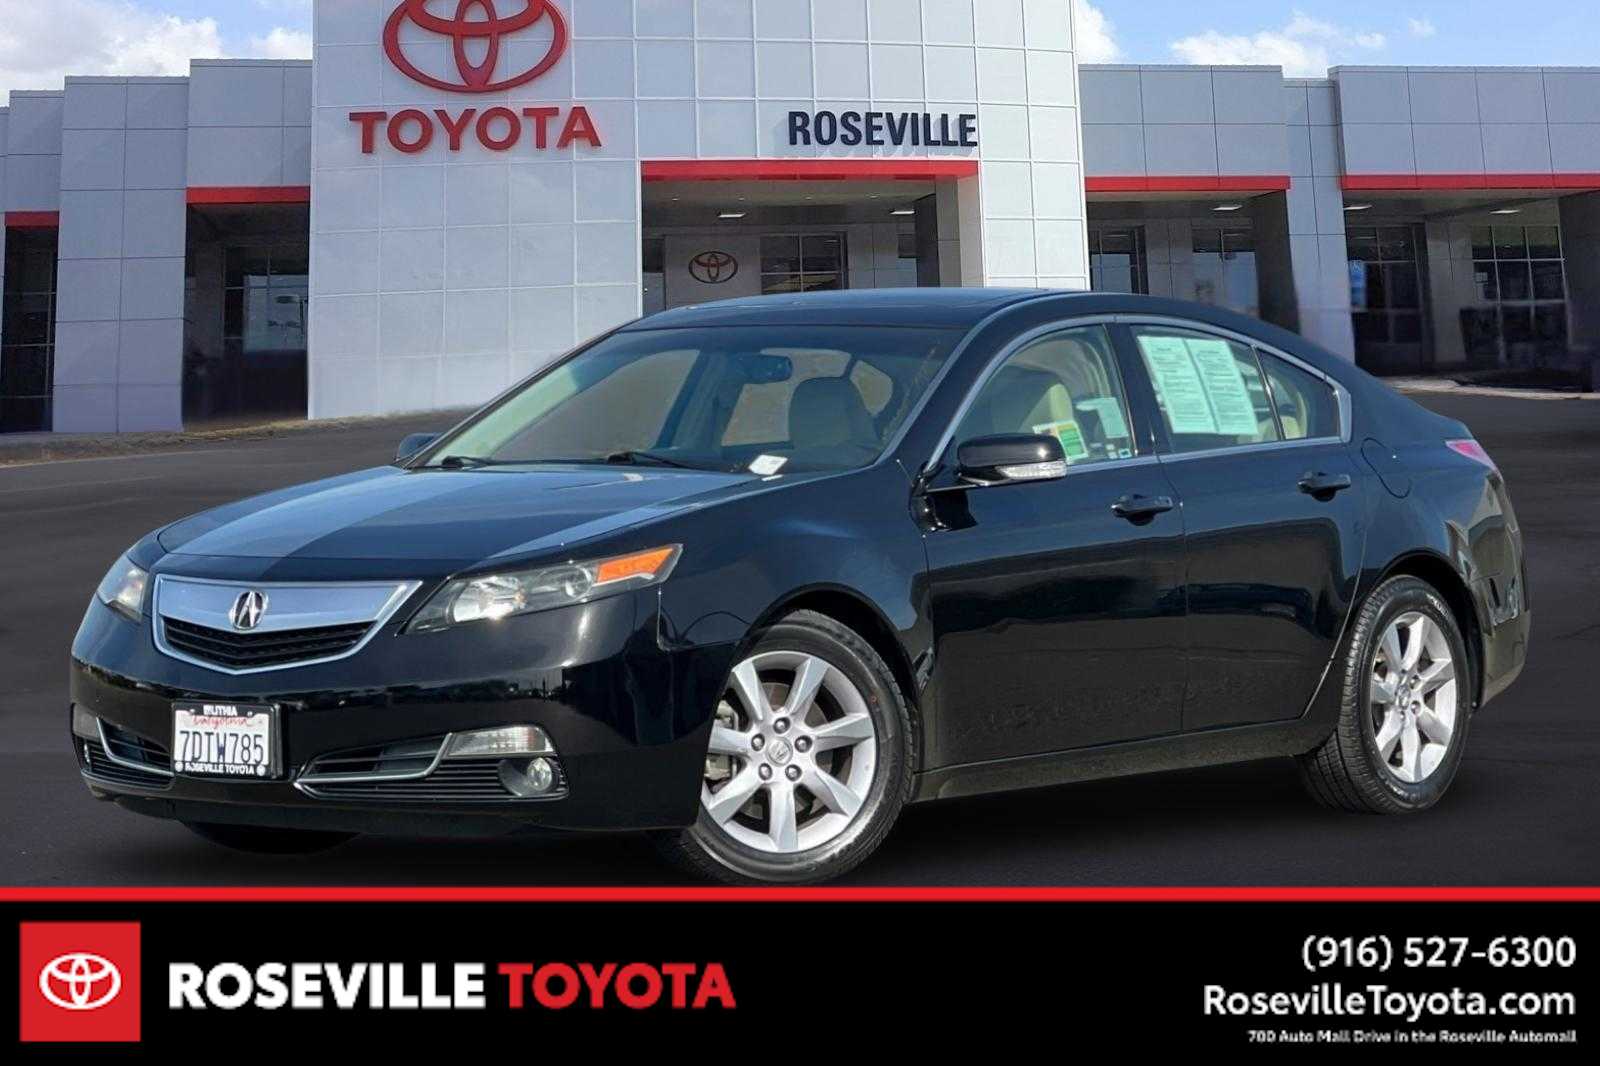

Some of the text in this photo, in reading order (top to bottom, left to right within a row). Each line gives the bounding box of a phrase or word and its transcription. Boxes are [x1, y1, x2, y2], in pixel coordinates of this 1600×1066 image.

[349, 106, 602, 154] TOYOTA
[788, 111, 978, 147] ROSEVILLE
[179, 730, 264, 764] 7DTW785
[184, 762, 255, 775] ROSEVILLE TOYOTA
